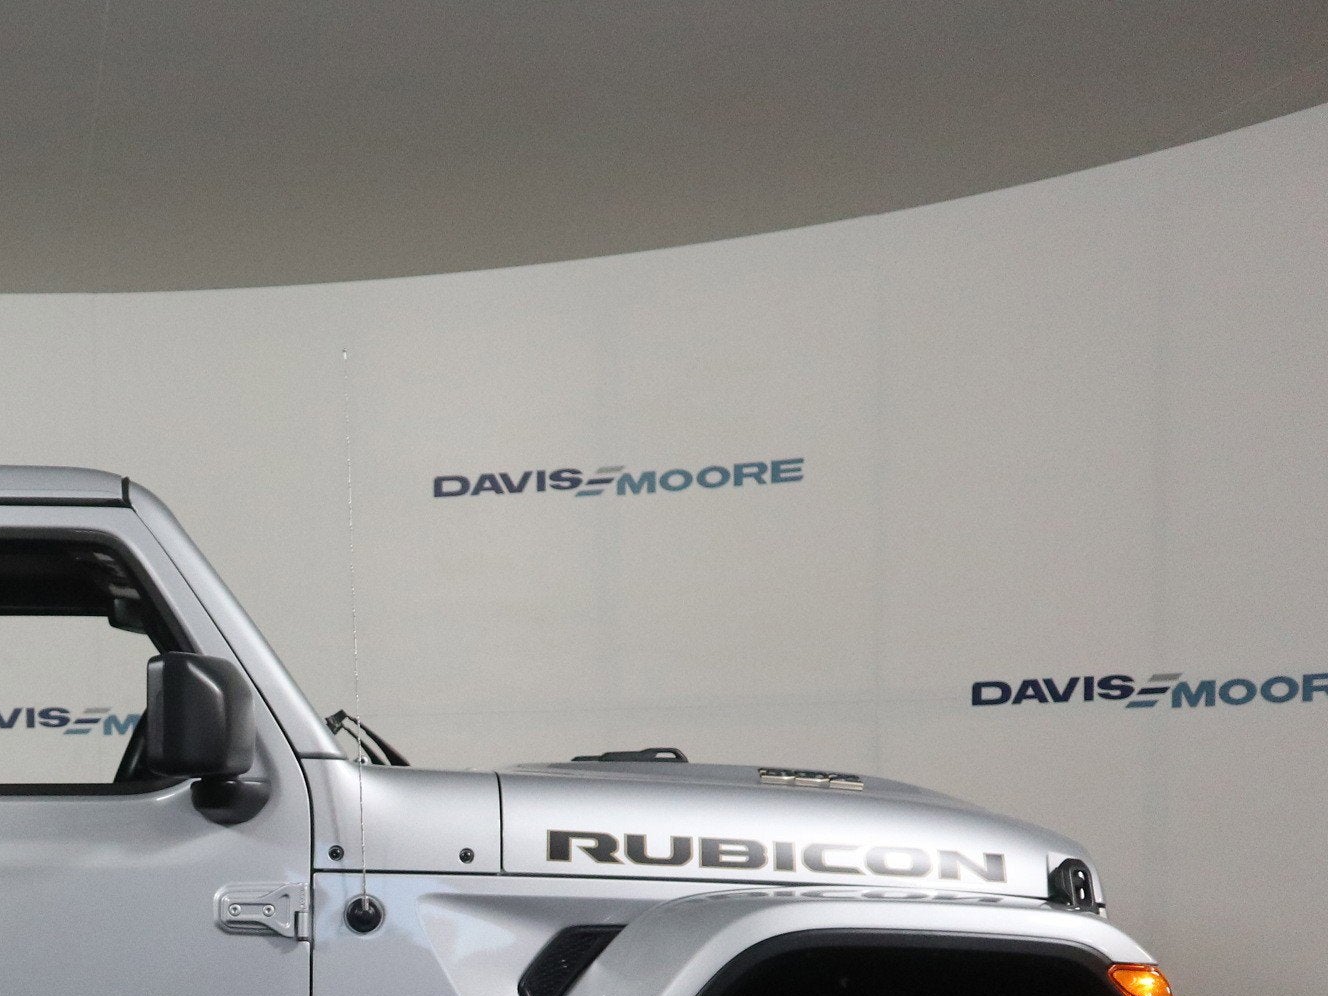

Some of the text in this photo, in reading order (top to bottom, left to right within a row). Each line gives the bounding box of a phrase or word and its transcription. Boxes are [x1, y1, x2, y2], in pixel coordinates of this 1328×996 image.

[433, 458, 804, 498] DAVIS MOORE
[971, 674, 1135, 706] DAVIS
[546, 829, 1008, 883] RUBICON
